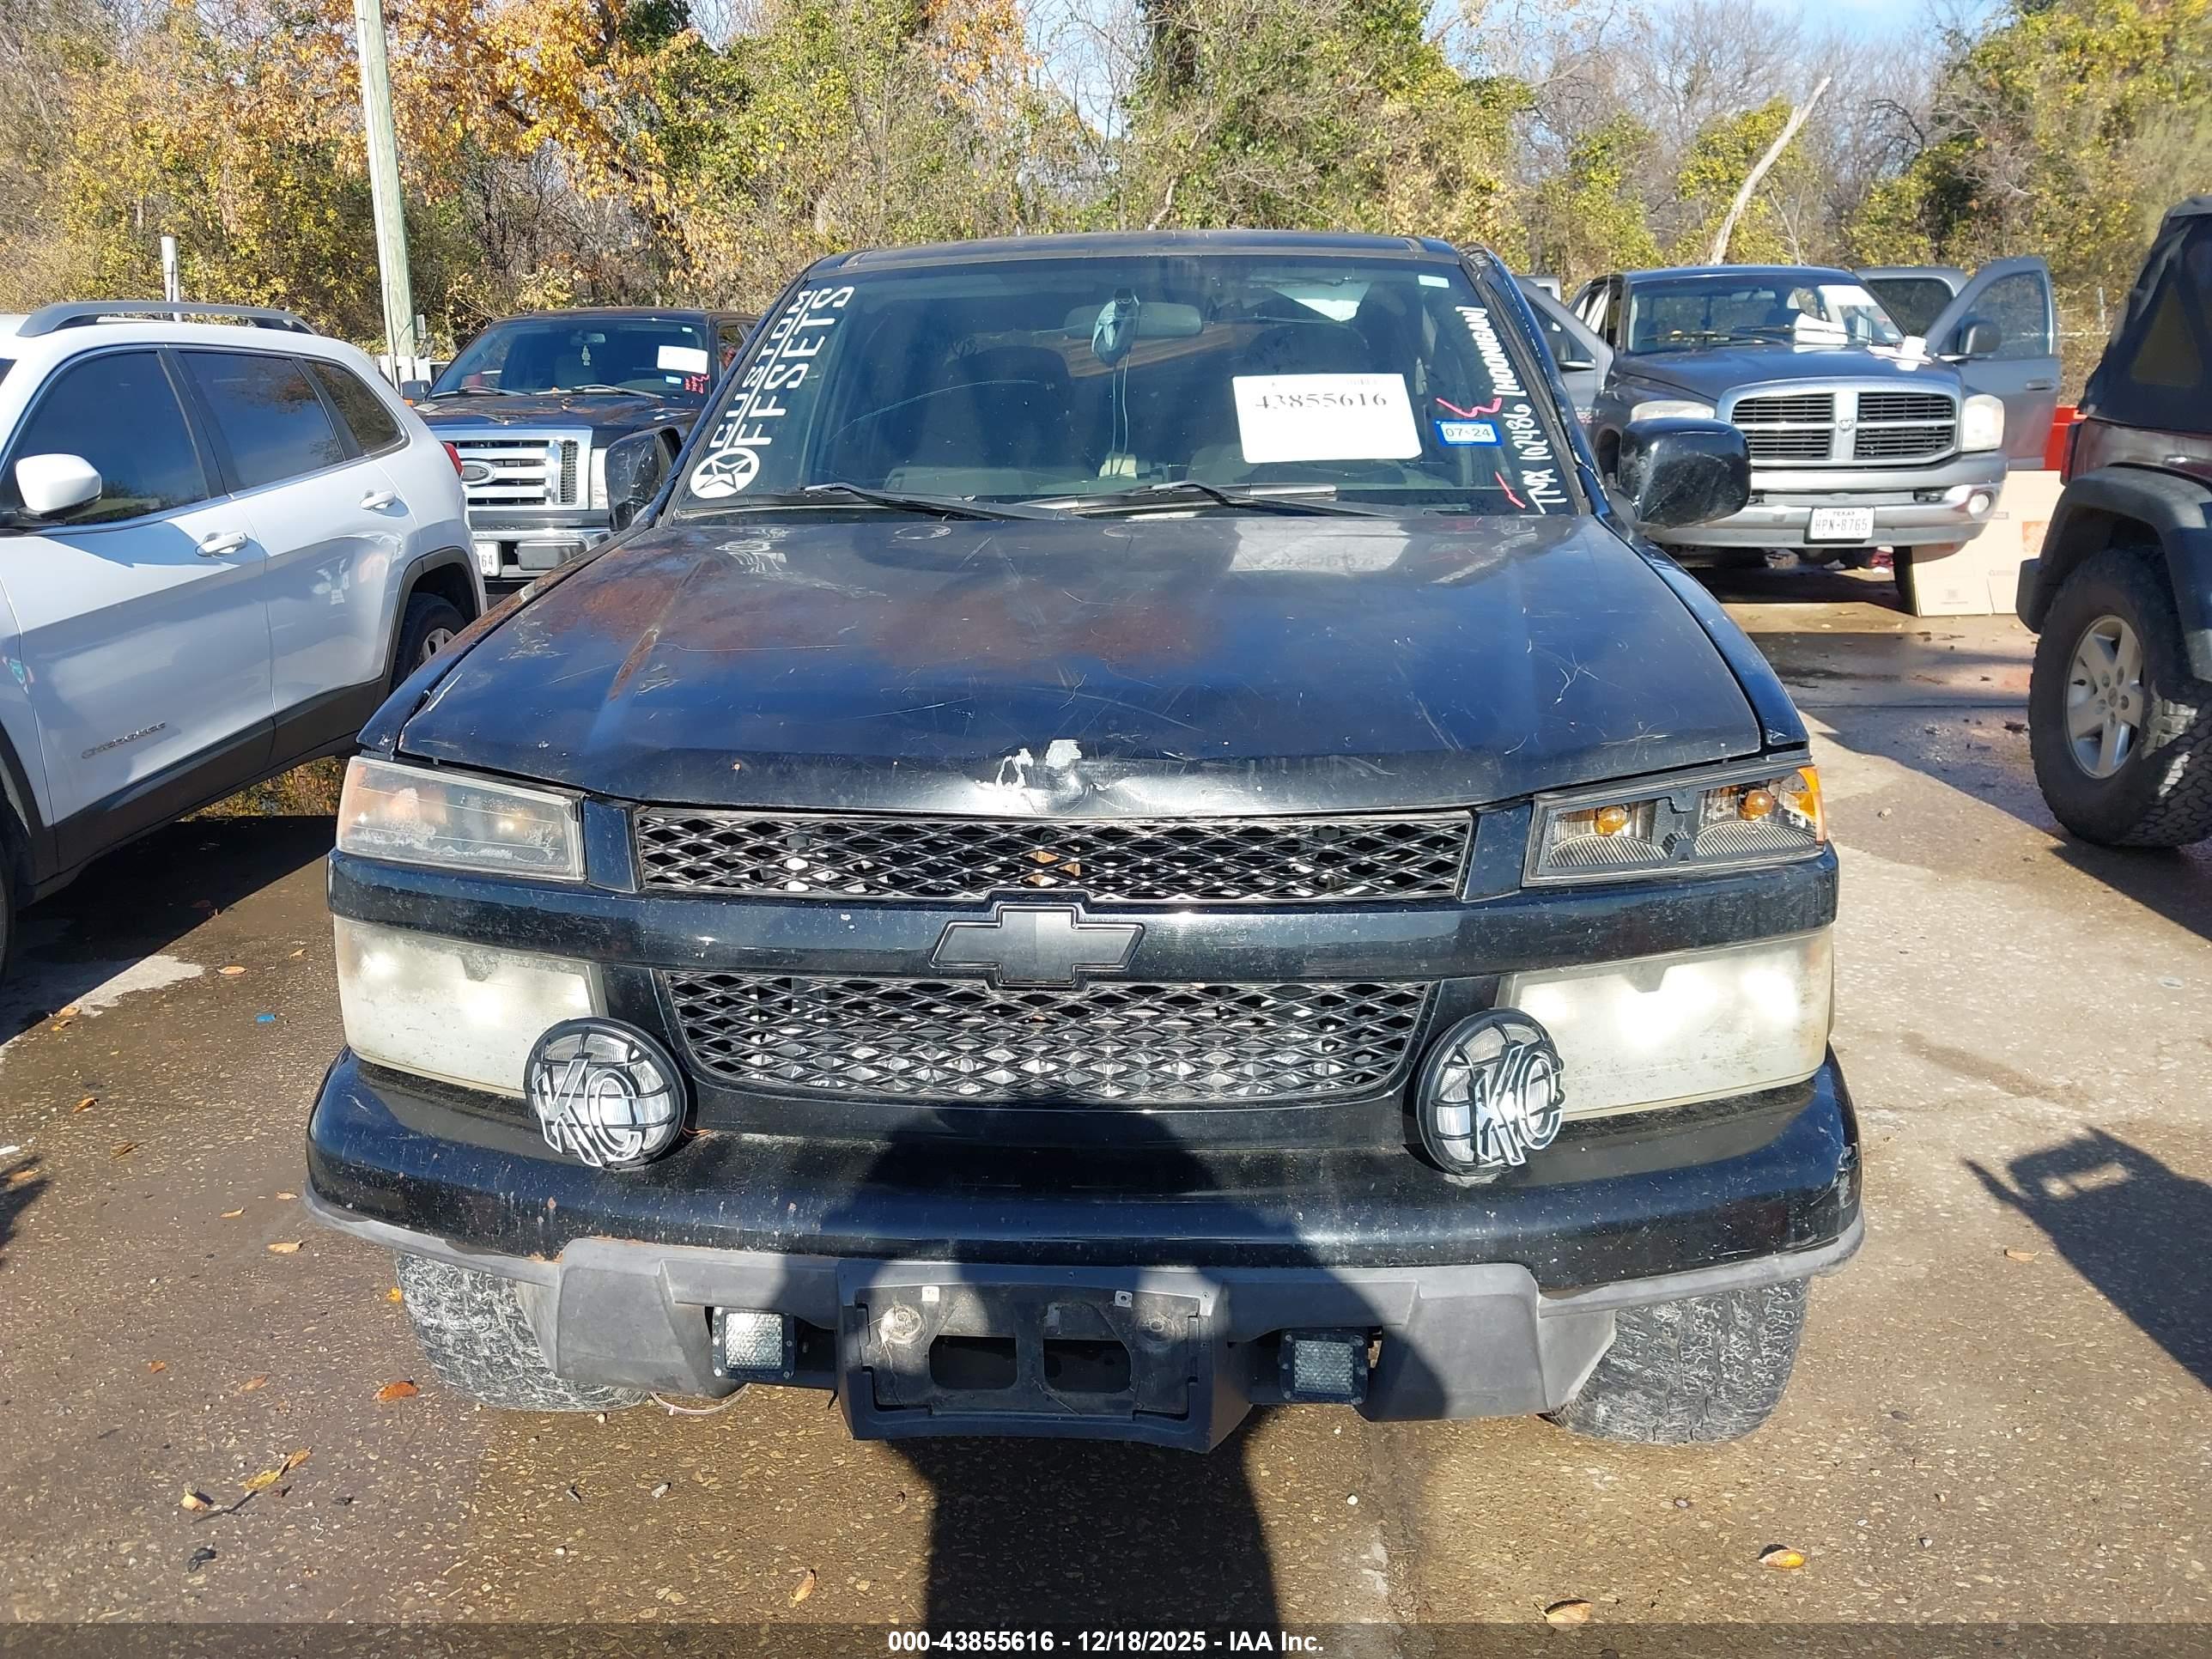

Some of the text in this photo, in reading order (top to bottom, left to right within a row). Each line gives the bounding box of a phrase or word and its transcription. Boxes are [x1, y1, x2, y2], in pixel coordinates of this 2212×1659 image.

[708, 289, 812, 448] CUSTOM
[1255, 392, 1388, 410] 43855616
[534, 1058, 643, 1167] KC
[1474, 1043, 1564, 1165] KC
